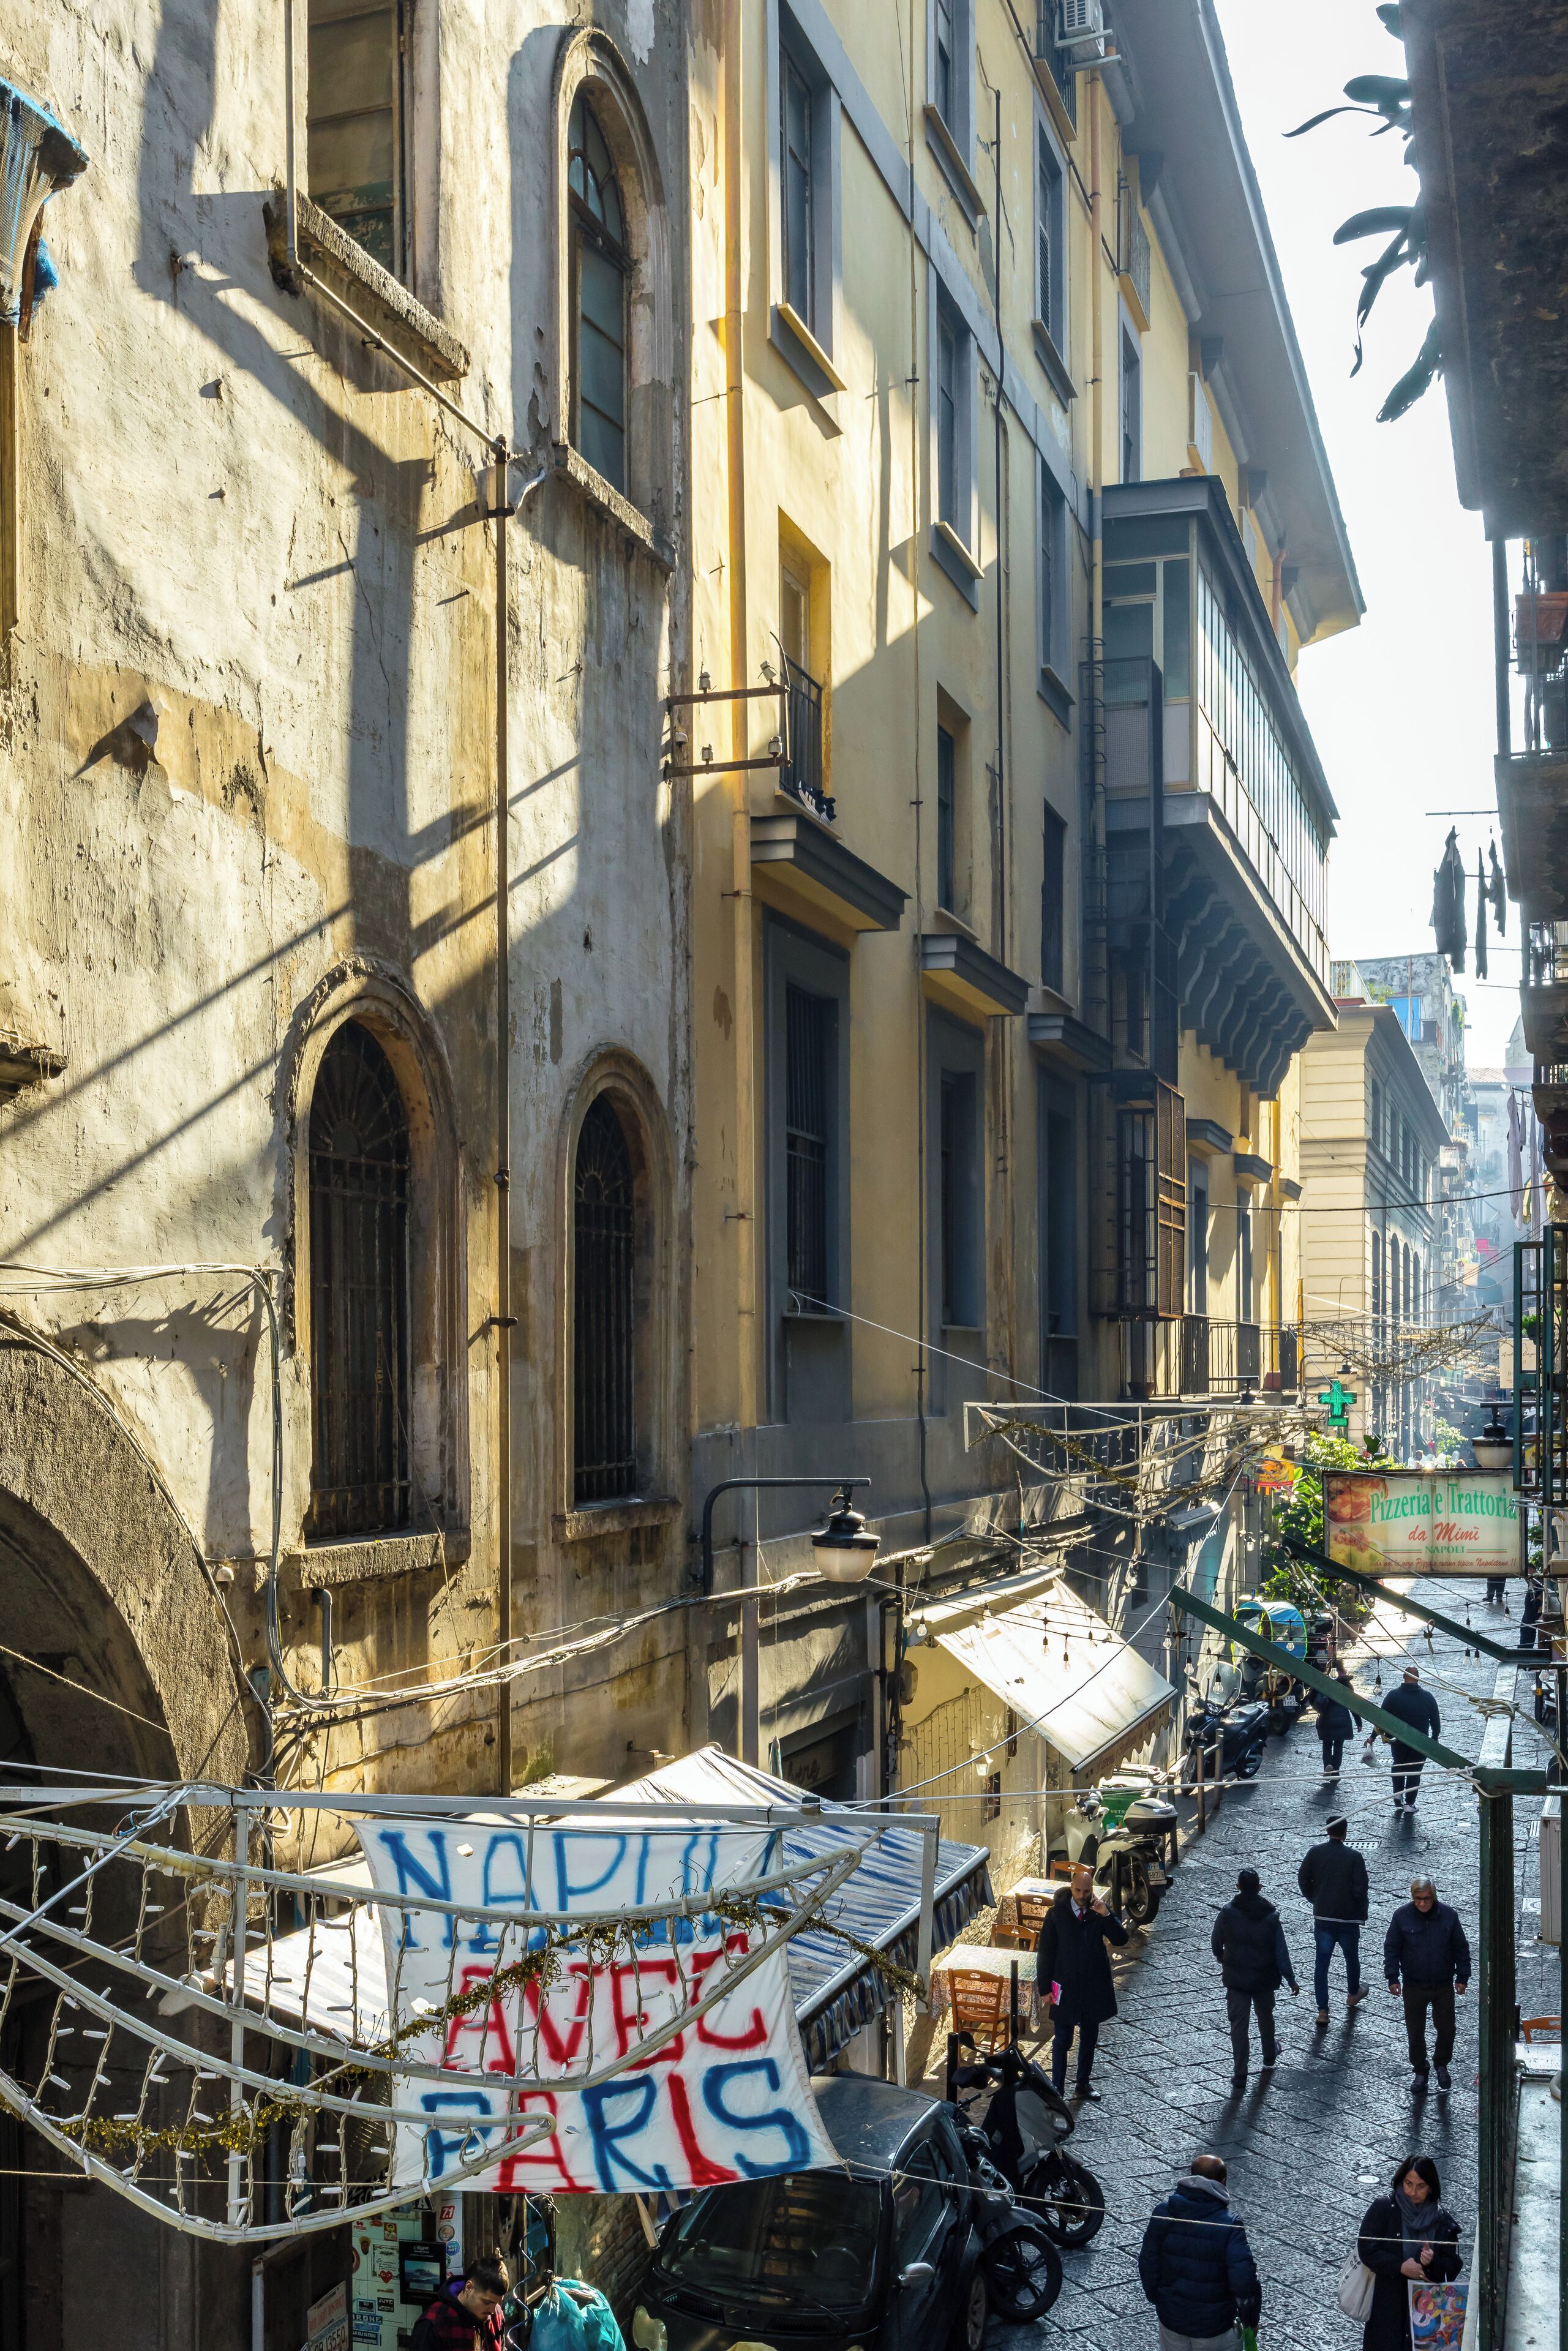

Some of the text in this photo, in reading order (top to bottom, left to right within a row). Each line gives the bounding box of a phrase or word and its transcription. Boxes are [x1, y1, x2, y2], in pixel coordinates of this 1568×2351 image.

[1370, 1483, 1517, 1524] Pizzeria e Trattoria
[1408, 1521, 1480, 1542] da Mimì
[1416, 1558, 1431, 1569] Pizza
[1457, 1559, 1474, 1568] tipica
[1476, 1558, 1509, 1568] Napoletana
[1425, 1545, 1465, 1554] NAPOLI
[436, 1932, 767, 2076] AVEC
[421, 2057, 812, 2193] PARIS
